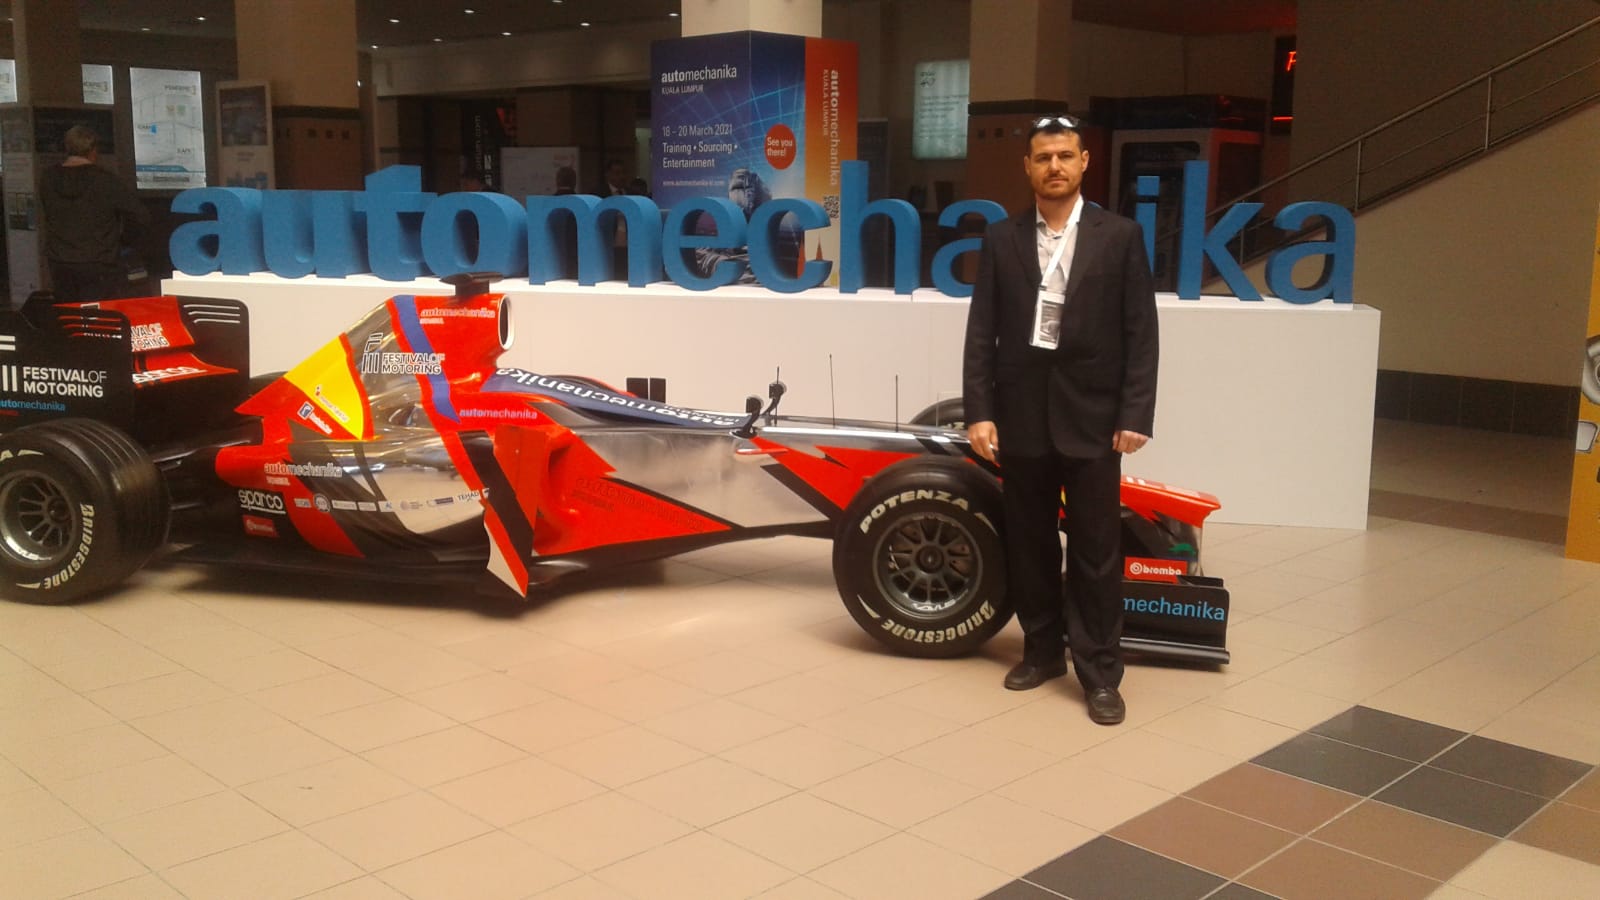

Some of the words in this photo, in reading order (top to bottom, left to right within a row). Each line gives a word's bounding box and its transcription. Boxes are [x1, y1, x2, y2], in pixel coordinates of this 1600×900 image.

[661, 64, 737, 83] automechanika
[661, 86, 680, 95] KUALA
[681, 84, 704, 94] LUMPUR
[678, 125, 688, 136] 20
[689, 124, 714, 136] March
[714, 124, 733, 136] 2021
[829, 69, 840, 186] automechanika
[662, 142, 692, 155] Training
[698, 142, 733, 154] Sourcing
[767, 137, 779, 147] See
[780, 138, 793, 149] you
[767, 147, 787, 157] there!
[662, 157, 715, 169] Entertainment
[169, 159, 1356, 305] automechaika
[381, 363, 442, 375] MOTORING
[23, 380, 104, 398] MOTORING
[459, 407, 538, 420] automechanika
[264, 461, 343, 478] automechanika
[237, 488, 284, 512] sparco
[859, 489, 969, 535] POTENZA
[44, 502, 95, 590] BRIDGESTONE
[1142, 560, 1182, 576] brembo
[1123, 596, 1225, 622] mechanika
[881, 600, 996, 644] BRIDGESTONE
